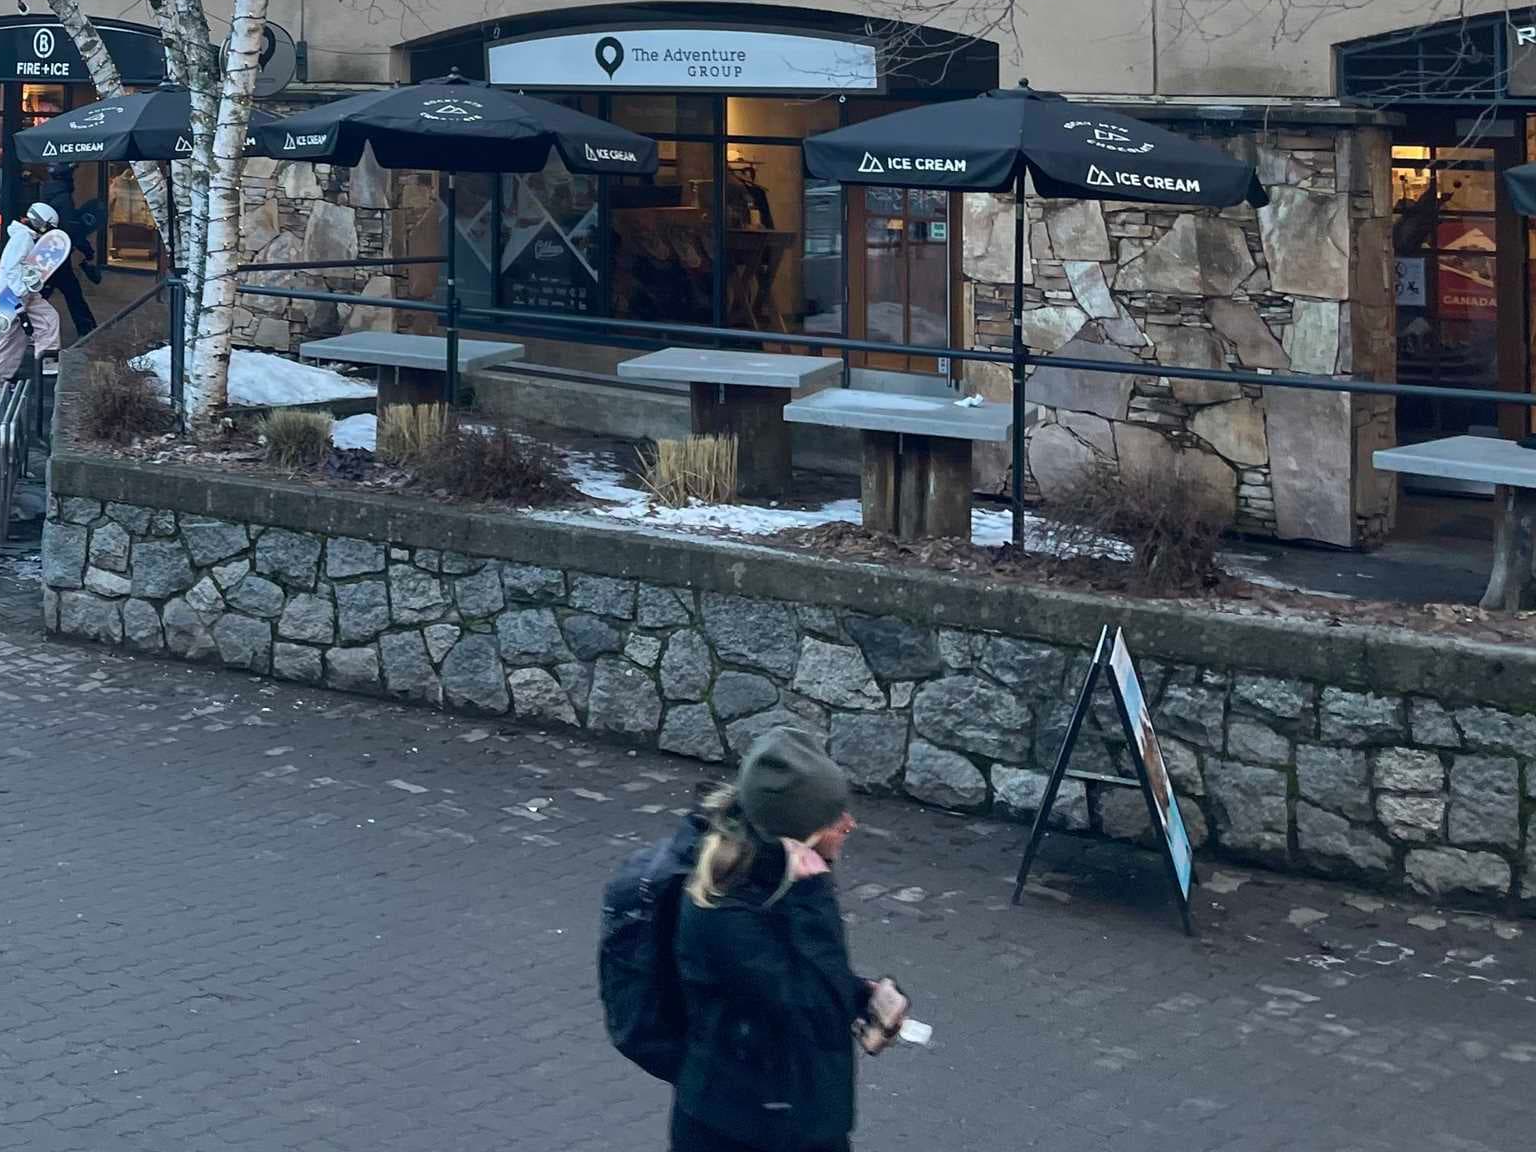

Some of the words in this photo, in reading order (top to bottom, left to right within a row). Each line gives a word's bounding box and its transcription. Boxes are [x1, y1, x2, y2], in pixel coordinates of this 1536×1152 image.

[631, 48, 659, 62] The
[663, 48, 746, 62] Adventure
[16, 62, 70, 76] FIRE+ICE
[687, 66, 743, 78] GROUP
[59, 143, 74, 153] ICE
[75, 142, 104, 152] CREAM
[596, 148, 610, 160] ICE
[609, 150, 637, 162] CREAM
[887, 157, 912, 169] ICE
[915, 158, 966, 172] CREAM
[1115, 171, 1141, 186] ICE
[1144, 175, 1201, 193] CREAM
[1444, 295, 1497, 307] CANADA
